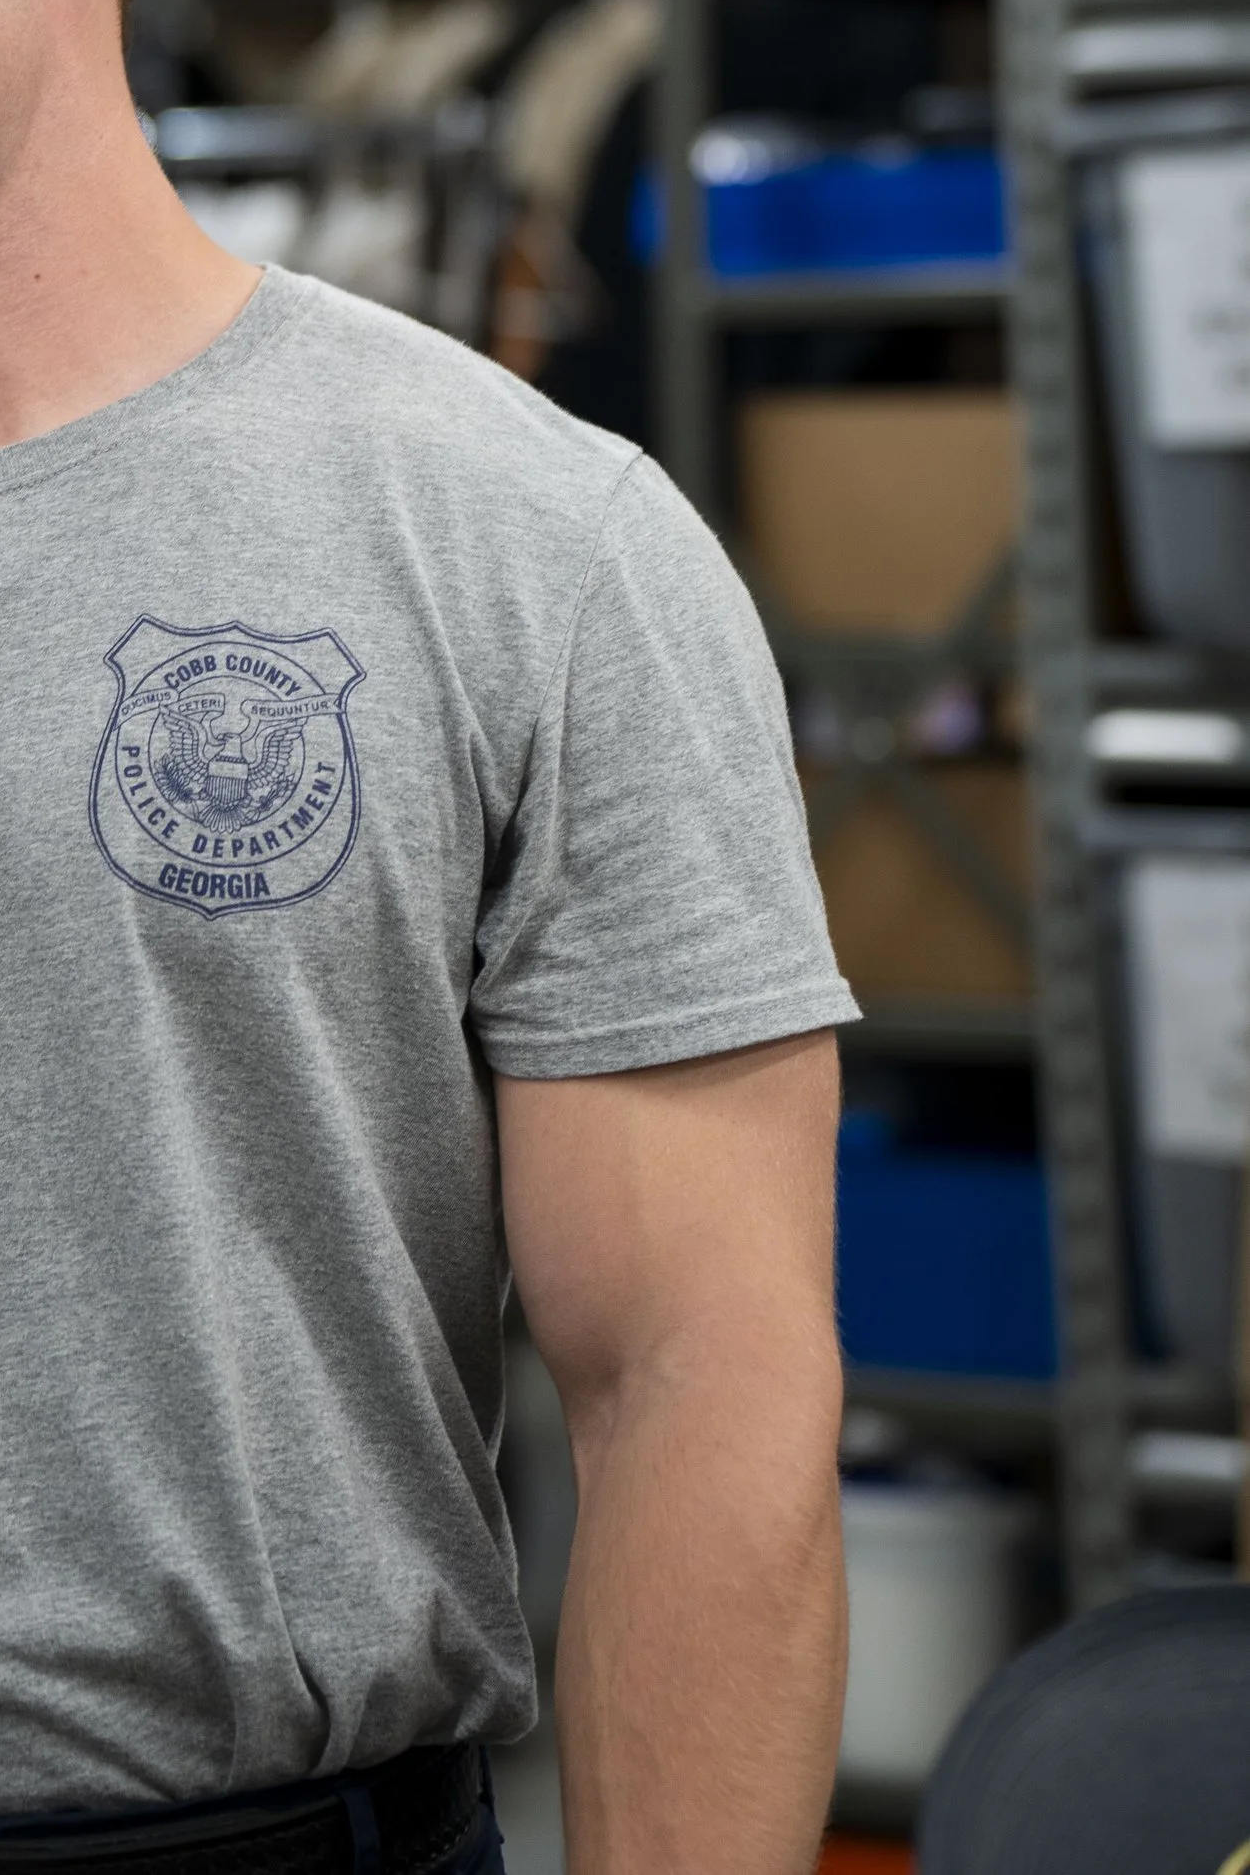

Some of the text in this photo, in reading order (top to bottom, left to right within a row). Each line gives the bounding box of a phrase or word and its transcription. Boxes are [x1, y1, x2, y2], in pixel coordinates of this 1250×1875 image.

[163, 654, 301, 698] COBB COUNTY
[177, 698, 221, 714] CETERI
[121, 744, 336, 859] POLICE DEPARTMENT
[157, 862, 271, 899] GEORGIA
